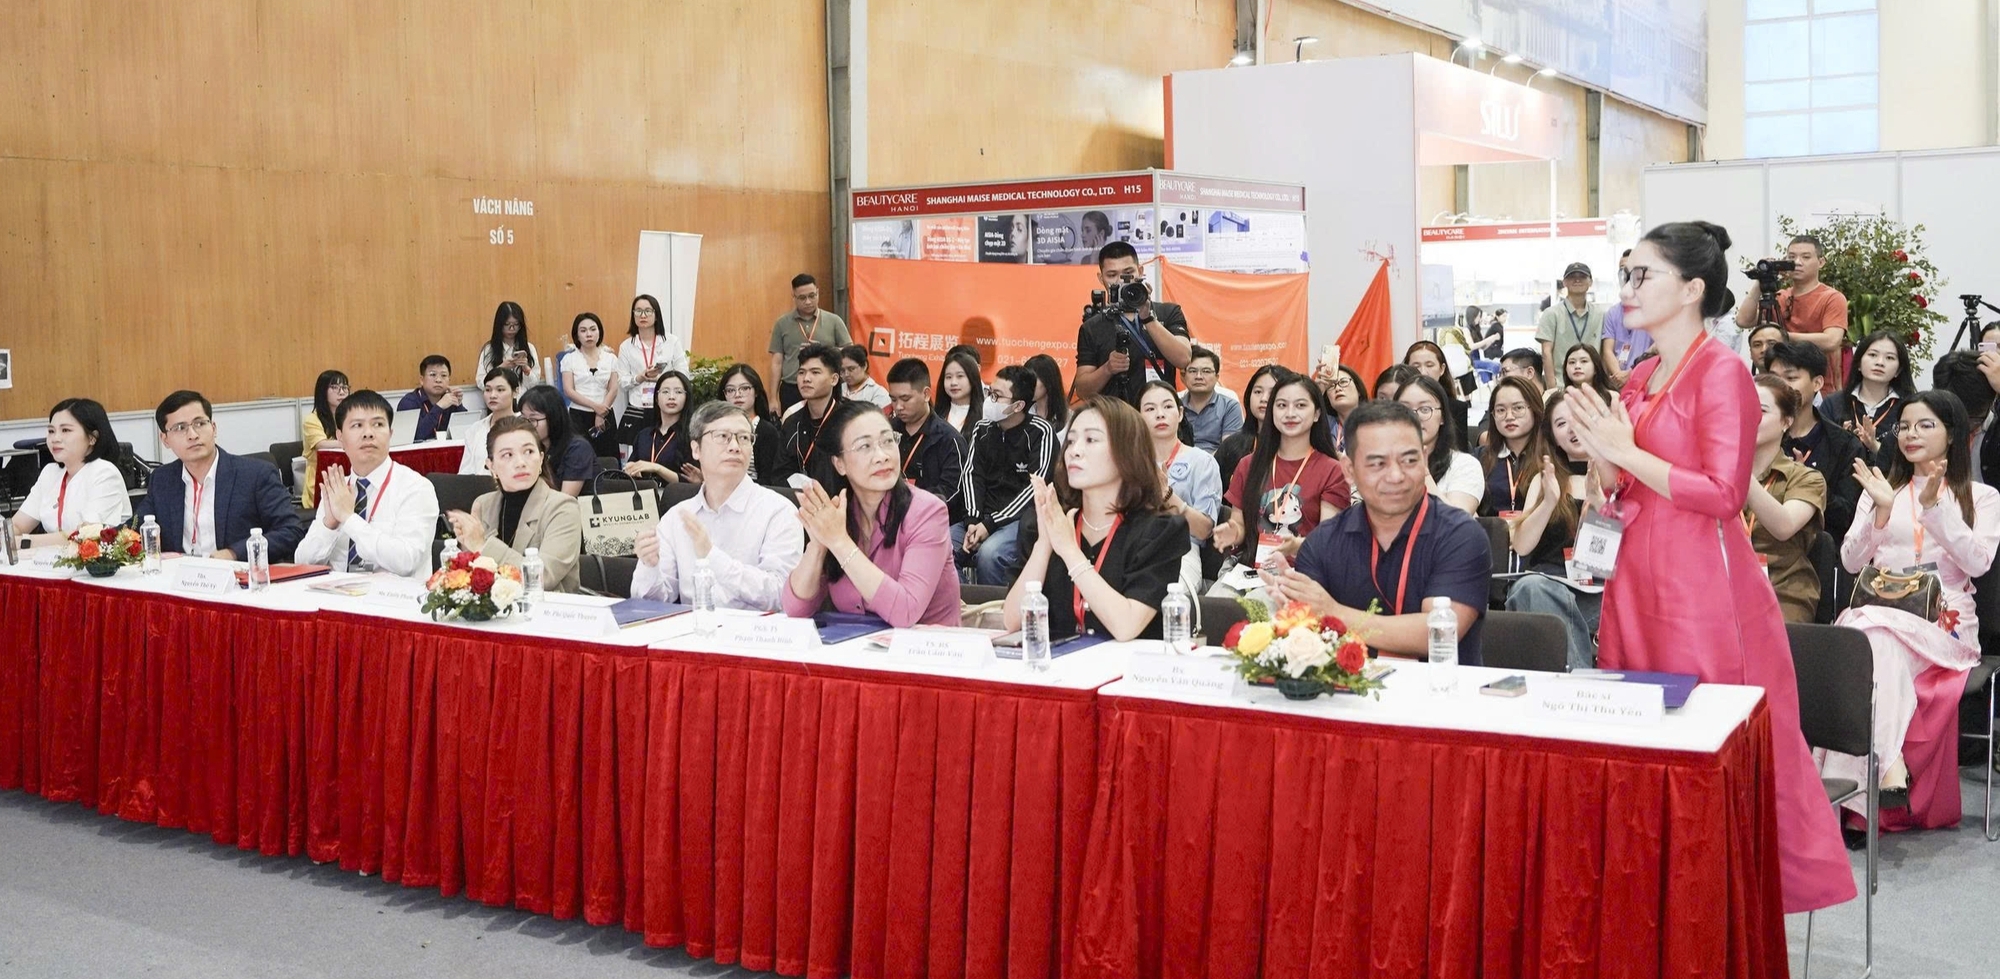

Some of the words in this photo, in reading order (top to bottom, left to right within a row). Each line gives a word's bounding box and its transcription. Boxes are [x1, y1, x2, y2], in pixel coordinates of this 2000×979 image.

[1160, 179, 1196, 192] BEAUTYCARE
[856, 193, 918, 206] BEAUTYCARE
[926, 195, 966, 205] SHANGHAI
[966, 194, 991, 203] MAISE
[992, 192, 1026, 202] MEDICAL
[1027, 188, 1080, 200] TECHNOLOGY
[1082, 188, 1097, 197] CO.,
[1099, 186, 1116, 195] LTD.
[1124, 185, 1142, 194] H15
[473, 196, 501, 214] VÁCH
[505, 198, 533, 216] NÂNG
[490, 224, 504, 245] SỐ
[507, 230, 514, 245] 5
[1423, 229, 1464, 237] BEAUTYCARE
[976, 336, 1077, 350] www.tuochengexpo.c
[997, 355, 1068, 367] 021-627
[602, 513, 650, 523] KYUNGLAB
[1592, 703, 1615, 714] Thu
